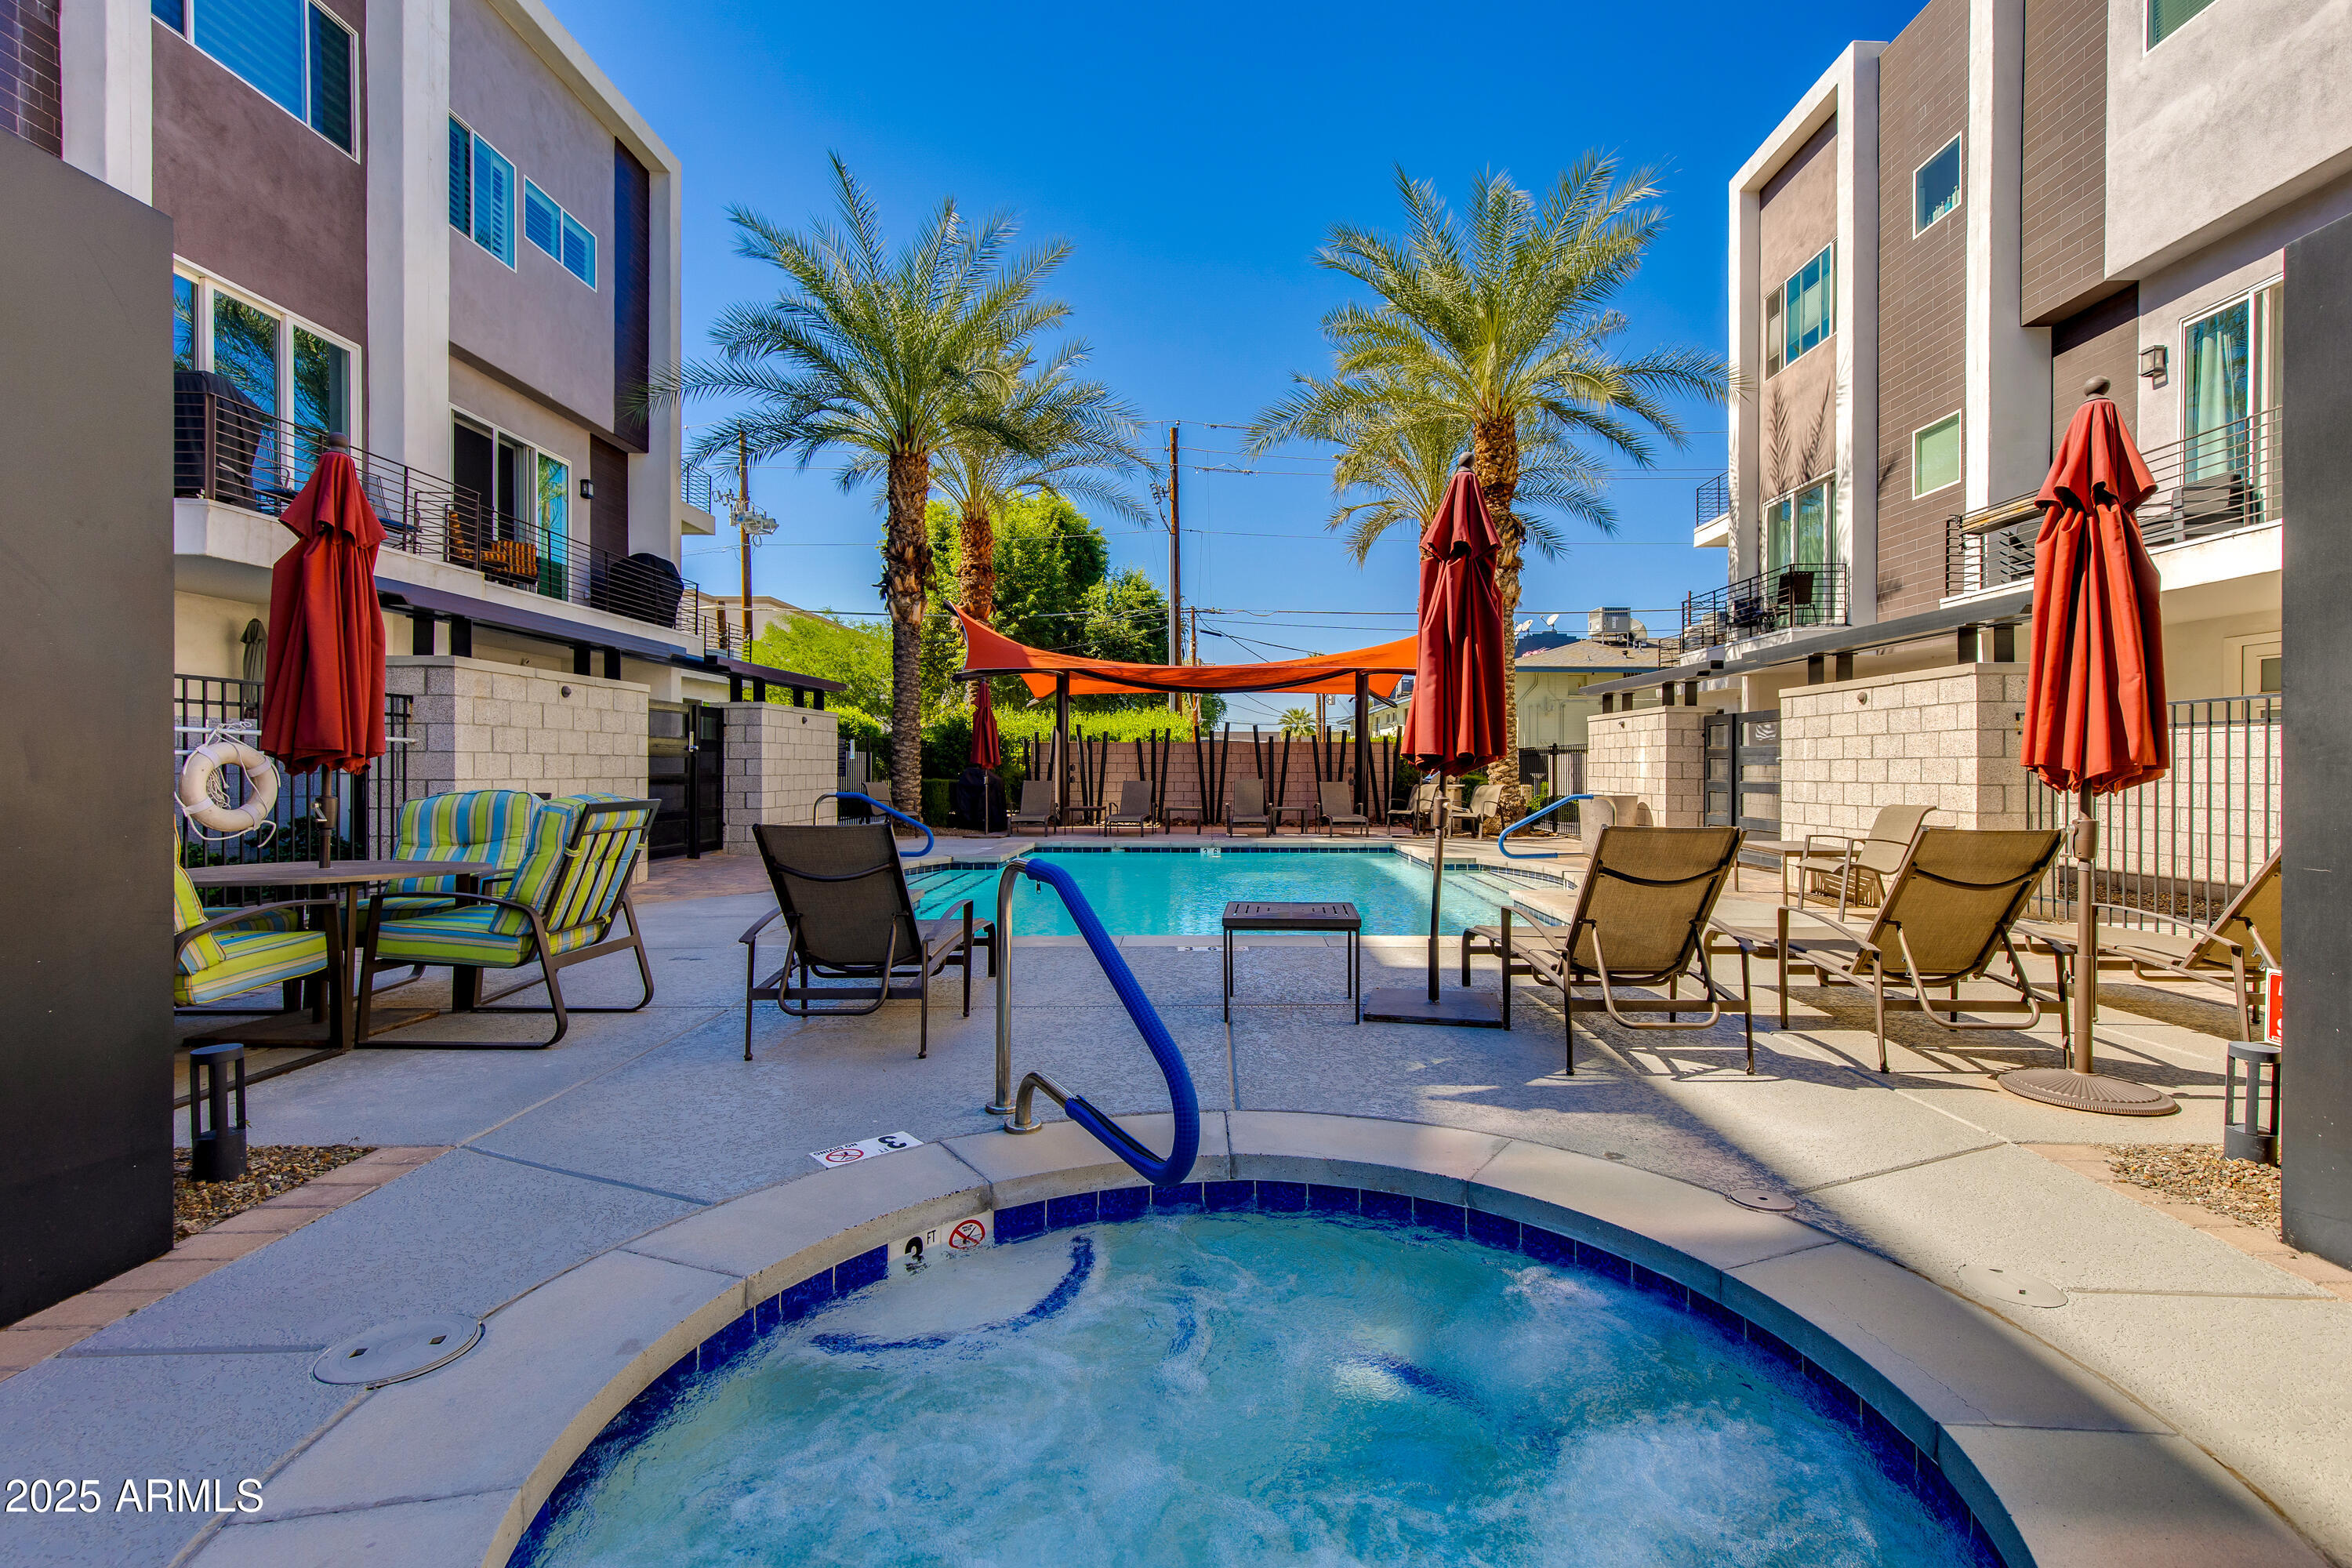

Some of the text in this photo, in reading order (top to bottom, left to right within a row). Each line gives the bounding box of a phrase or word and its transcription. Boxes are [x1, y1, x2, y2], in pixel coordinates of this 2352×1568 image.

[878, 1135, 907, 1149] 3
[813, 1146, 844, 1156] DIVING
[927, 1229, 936, 1244] FT
